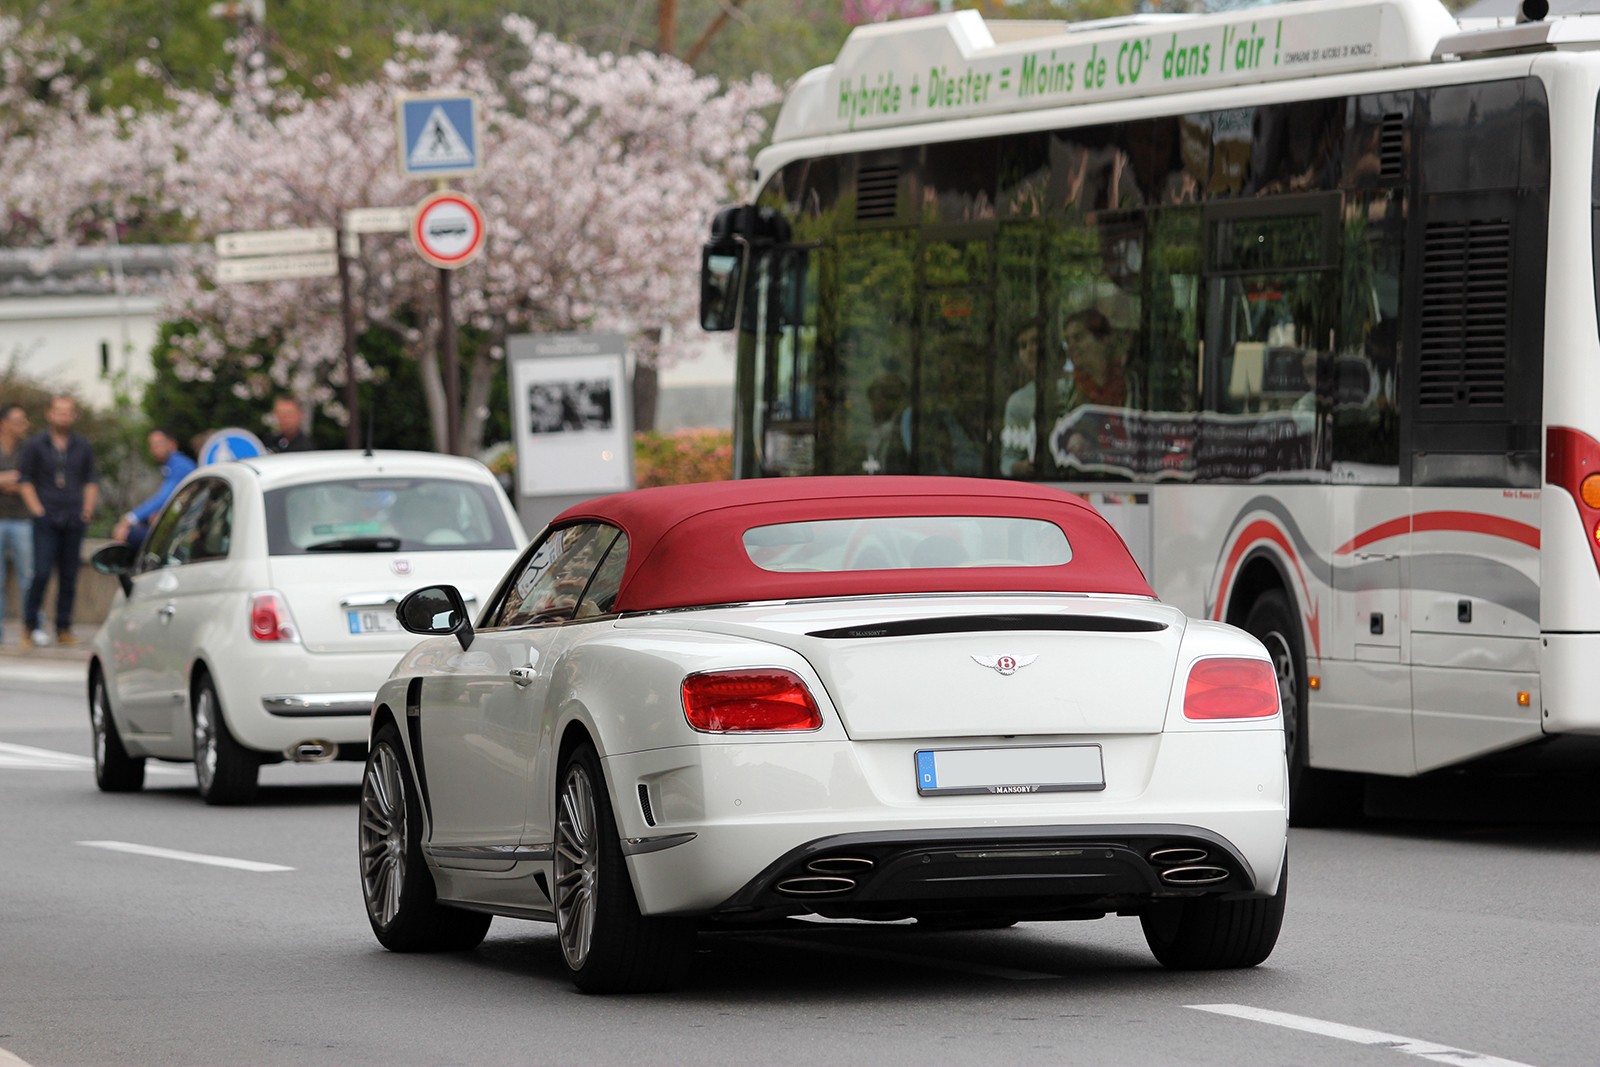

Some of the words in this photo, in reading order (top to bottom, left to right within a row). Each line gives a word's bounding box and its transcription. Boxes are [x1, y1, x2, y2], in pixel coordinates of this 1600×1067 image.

[838, 70, 901, 131] Hybride
[927, 66, 992, 108] Diester
[1018, 50, 1075, 97] Moins
[1083, 44, 1107, 89] de
[1163, 33, 1211, 80] dans
[924, 773, 932, 783] D
[996, 785, 1031, 794] MANSORY
